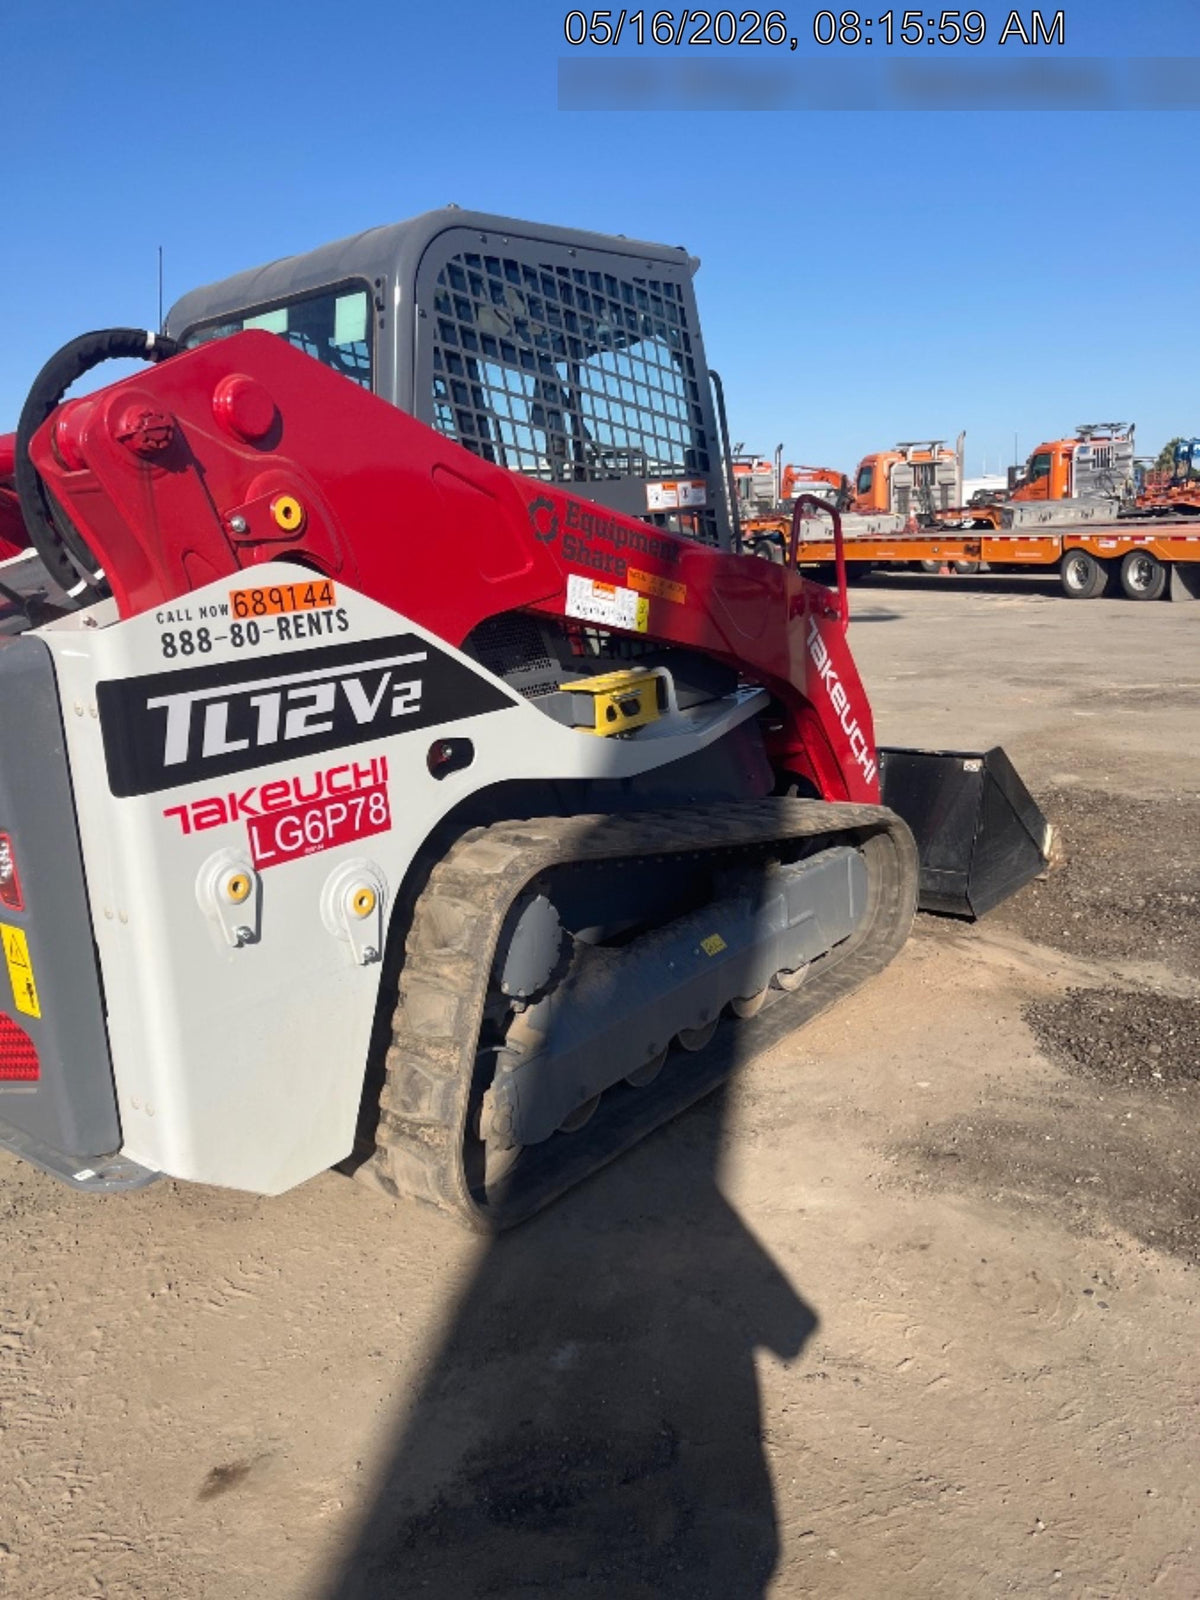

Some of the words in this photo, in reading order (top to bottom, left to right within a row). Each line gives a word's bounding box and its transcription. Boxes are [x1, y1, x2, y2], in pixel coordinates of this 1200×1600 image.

[561, 534, 628, 577] Share
[565, 500, 681, 564] Equipment
[156, 611, 193, 625] CALL
[199, 604, 229, 620] NOW
[234, 582, 333, 618] 689144
[161, 607, 349, 659] 888-80-RENTS
[147, 652, 427, 766] TL12V2
[252, 791, 389, 862] LG6P78
